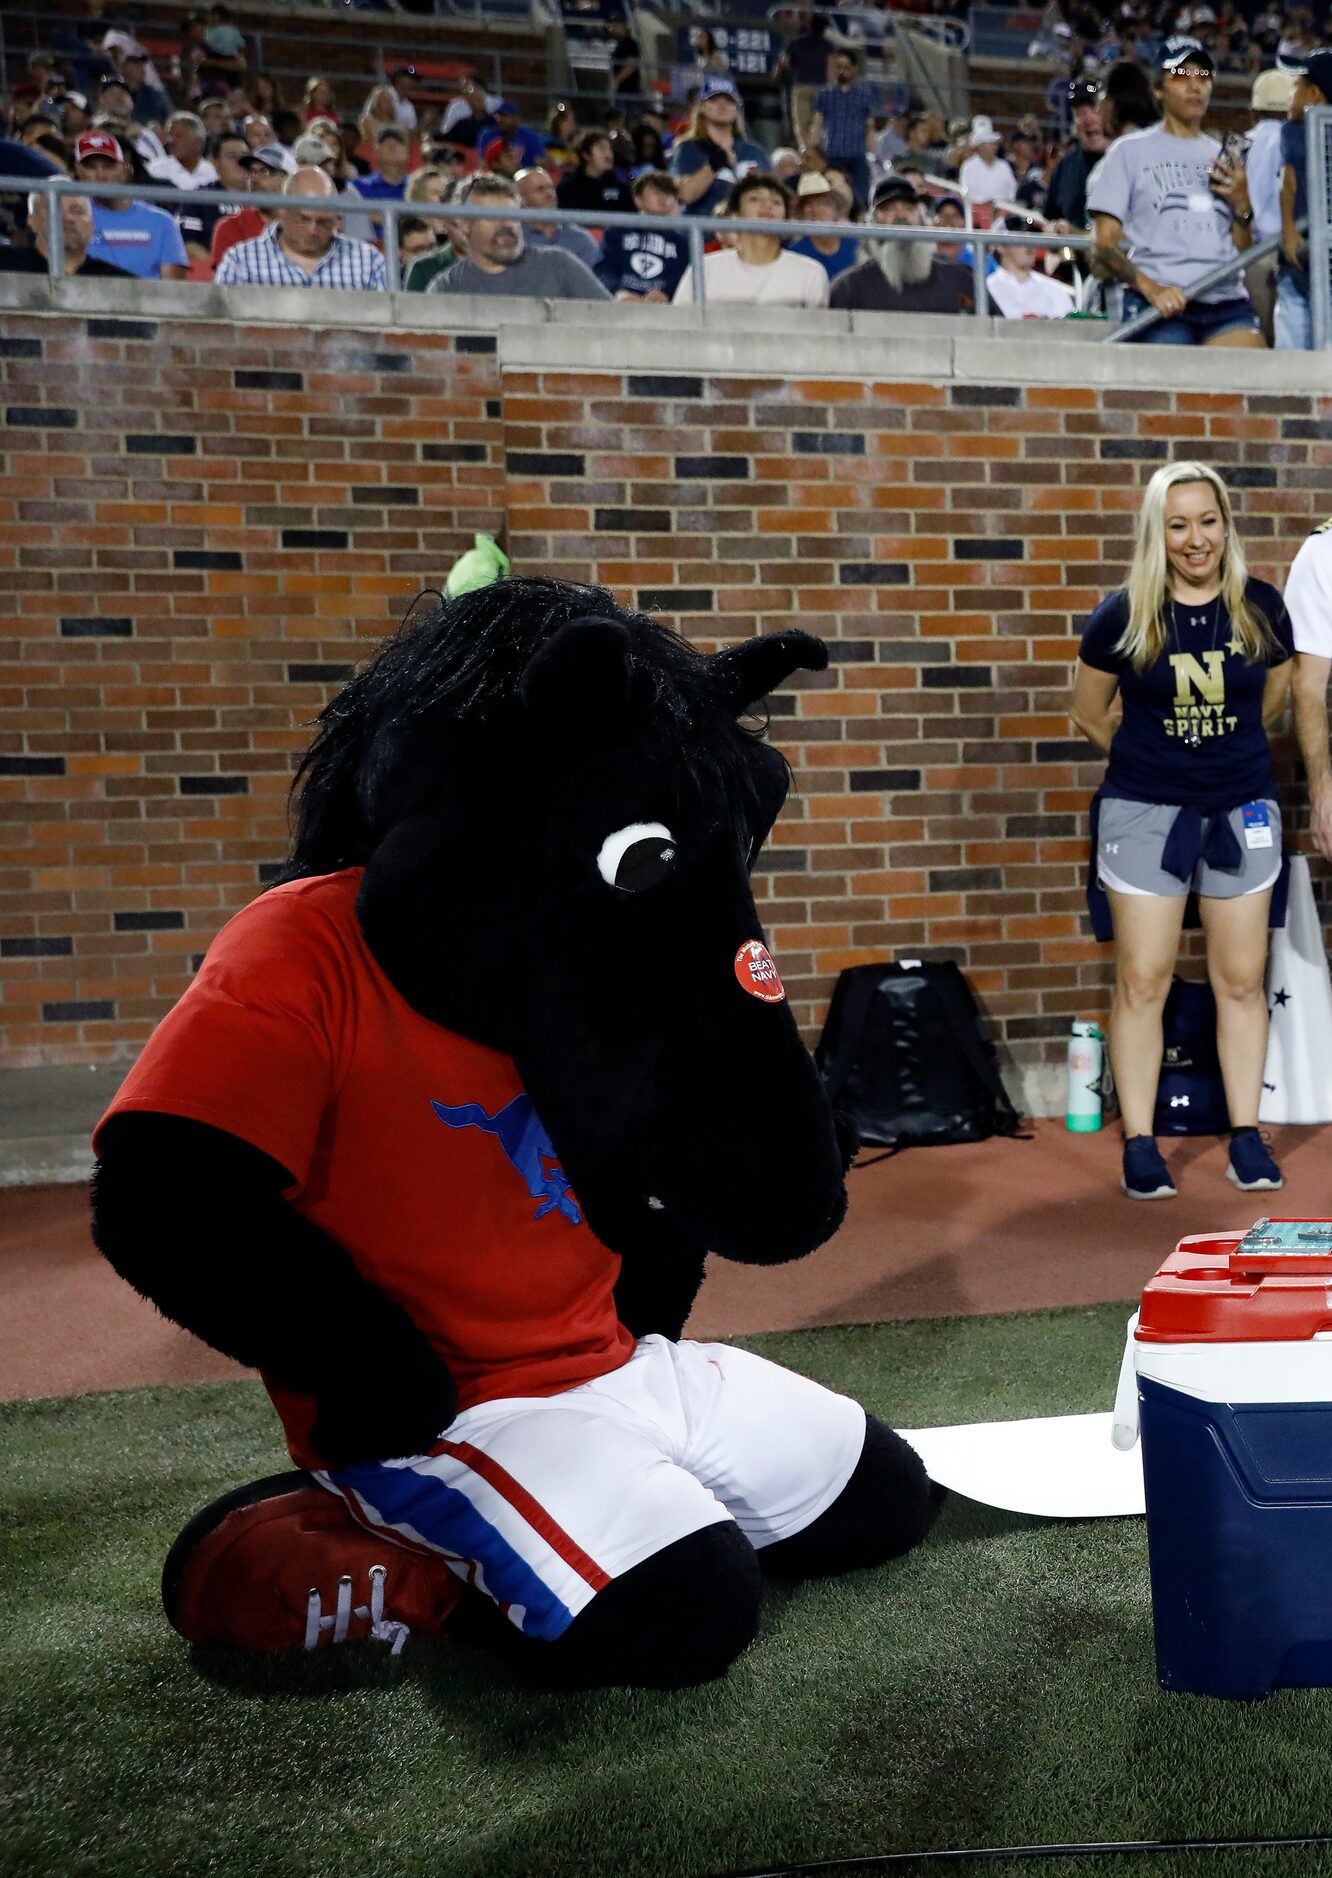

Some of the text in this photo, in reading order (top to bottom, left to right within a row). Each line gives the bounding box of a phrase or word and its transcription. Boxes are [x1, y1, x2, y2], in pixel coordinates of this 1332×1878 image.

[1168, 650, 1225, 706] N
[1174, 704, 1225, 719] NAVY
[1163, 716, 1238, 737] SPIRIT
[748, 959, 773, 972] BEAT
[751, 970, 777, 982] NAVY
